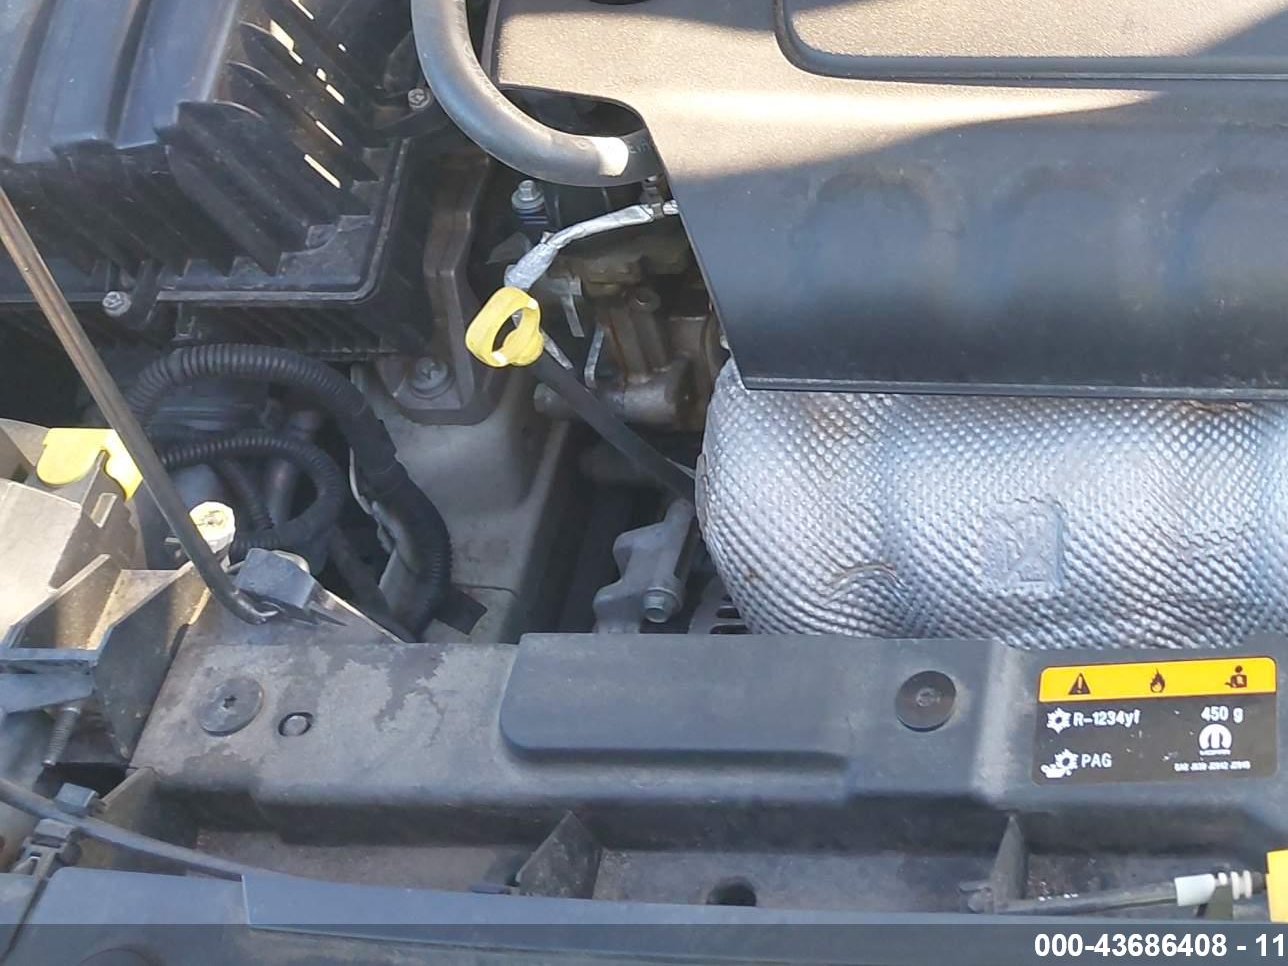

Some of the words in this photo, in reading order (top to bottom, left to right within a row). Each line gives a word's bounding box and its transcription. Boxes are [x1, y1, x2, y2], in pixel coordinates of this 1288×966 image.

[1073, 709, 1140, 728] R-1234yf
[1201, 705, 1228, 722] 450
[1233, 707, 1244, 724] g
[1081, 753, 1112, 768] PAG
